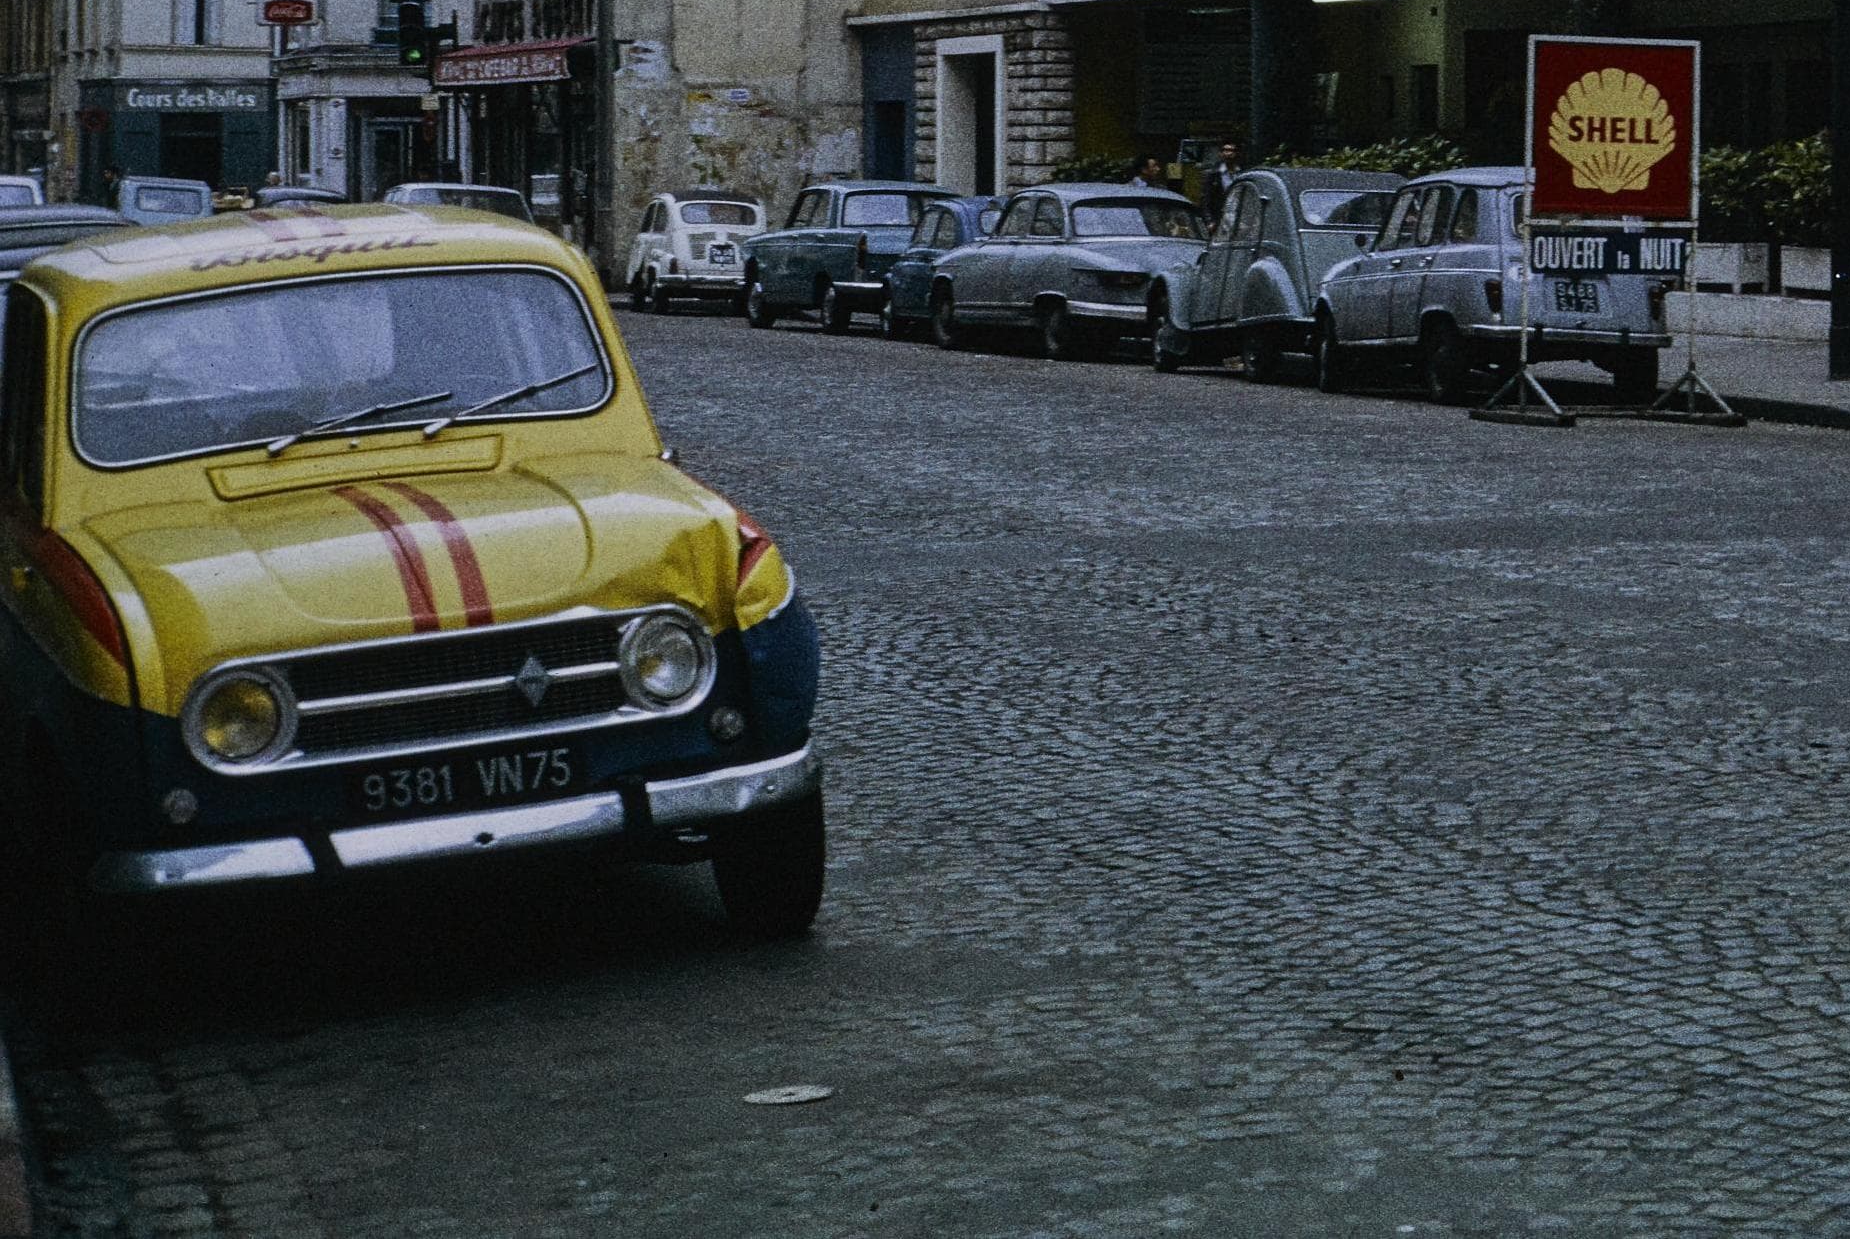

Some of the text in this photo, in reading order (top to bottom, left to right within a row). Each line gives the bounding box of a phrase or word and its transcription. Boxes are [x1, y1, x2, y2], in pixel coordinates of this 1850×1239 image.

[127, 88, 172, 108] Cours
[176, 87, 205, 107] des
[1568, 115, 1660, 146] SHELL
[1533, 236, 1608, 270] OUVERT
[1639, 238, 1684, 270] NUIT
[362, 764, 455, 811] 9381
